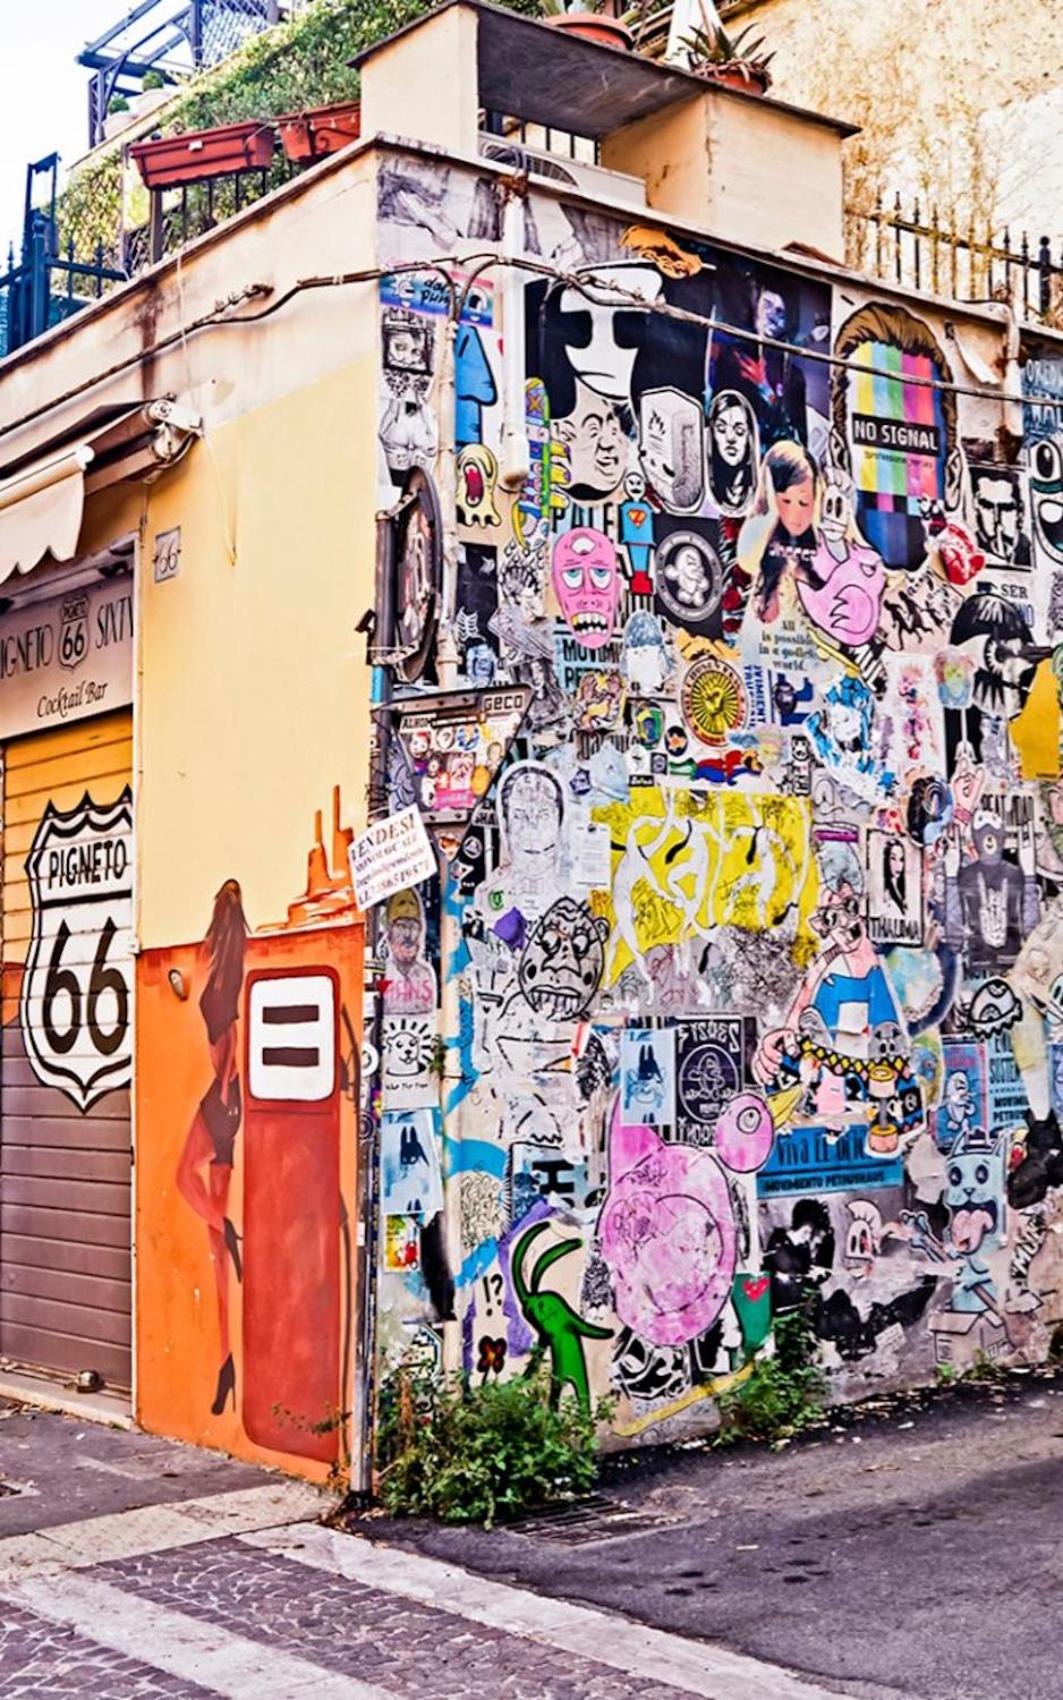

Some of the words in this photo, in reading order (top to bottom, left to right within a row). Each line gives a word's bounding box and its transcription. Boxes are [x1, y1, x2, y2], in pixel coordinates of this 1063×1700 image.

[854, 420, 877, 441] NO
[881, 424, 938, 451] SIGNAL
[0, 624, 53, 680] IGNETO
[63, 622, 85, 660] 66
[37, 681, 86, 718] Cocktail
[86, 682, 108, 705] Bar
[48, 839, 128, 889] PIGNETO
[42, 916, 129, 1056] 66
